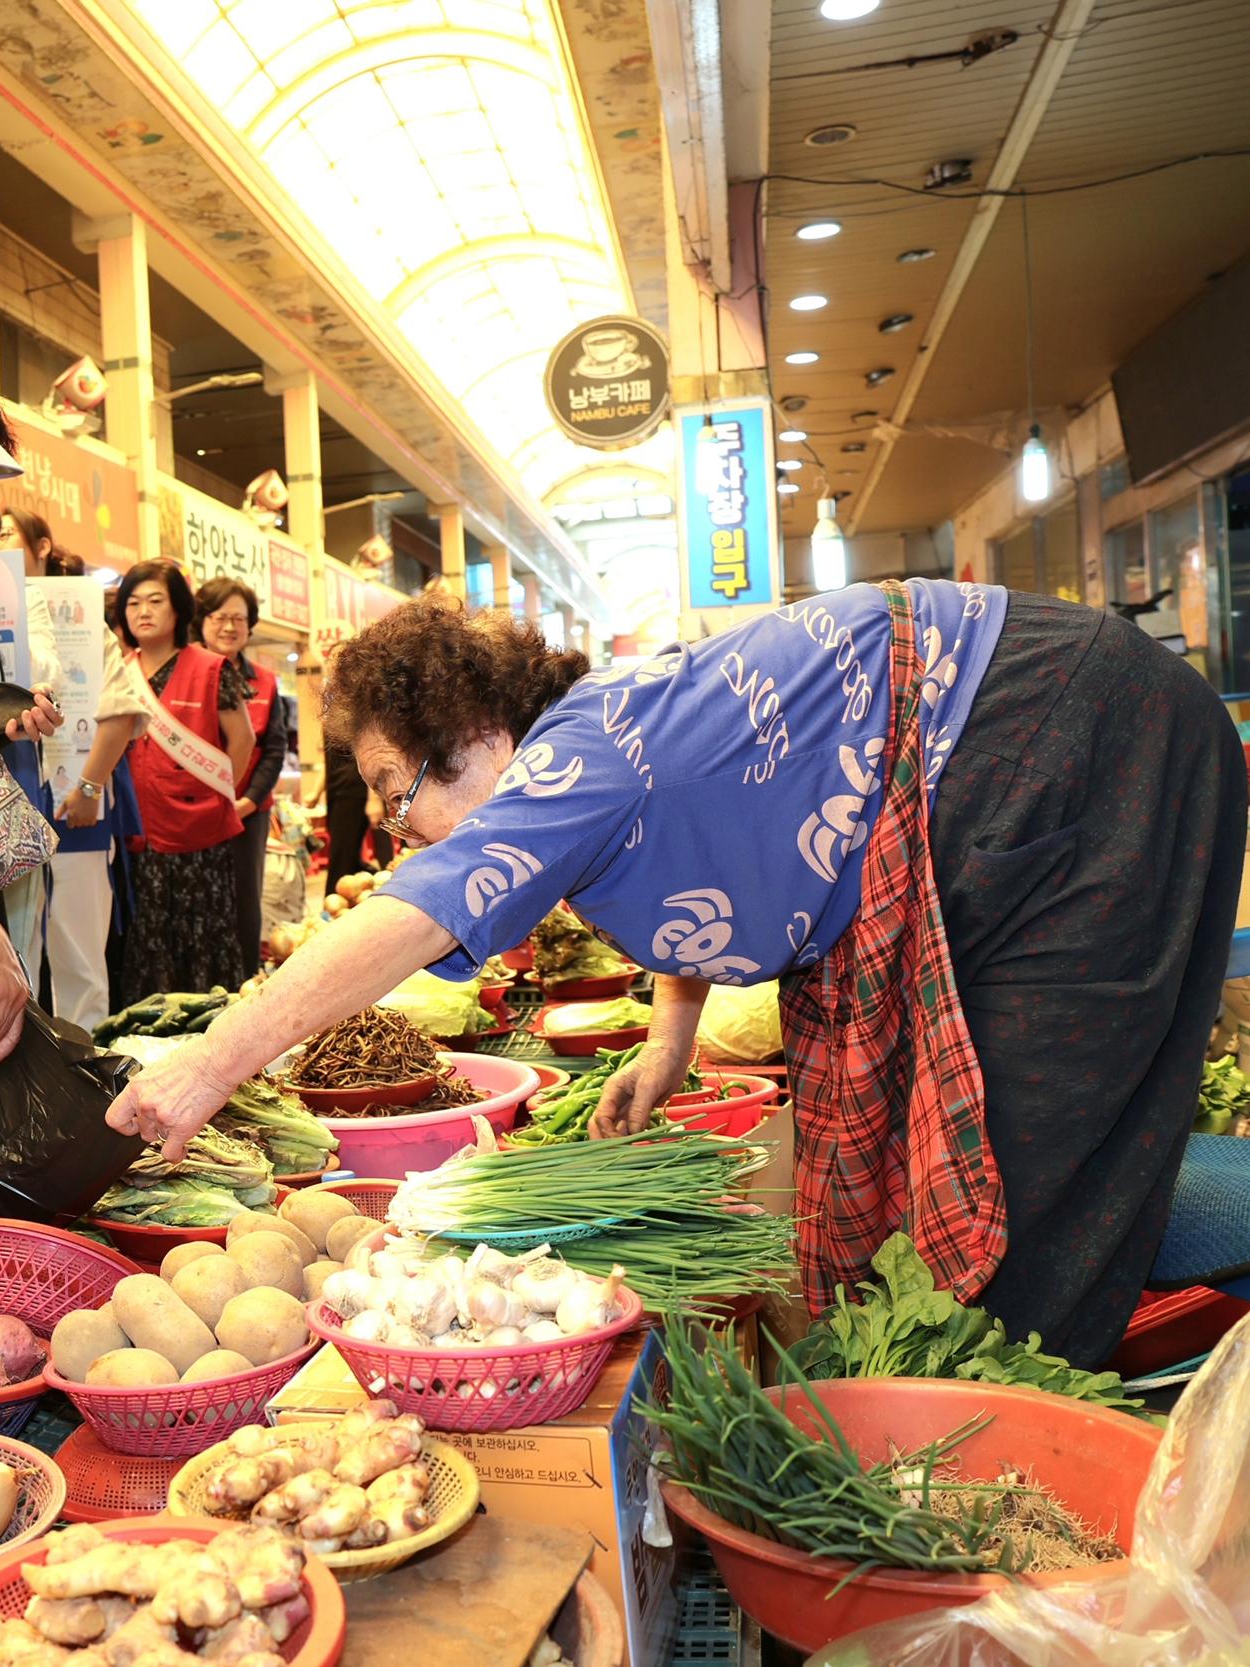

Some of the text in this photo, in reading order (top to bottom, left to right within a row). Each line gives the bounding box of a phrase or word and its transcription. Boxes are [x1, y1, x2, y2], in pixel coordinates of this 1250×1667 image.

[568, 379, 652, 410] 남부카페
[570, 402, 652, 423] NAMBU CAFE
[710, 528, 751, 598] 입구
[452, 1436, 473, 1449] 곳에
[476, 1437, 540, 1453] 보관하십시오.
[494, 1466, 535, 1481] 안심하고
[537, 1470, 582, 1484] 드십시오.
